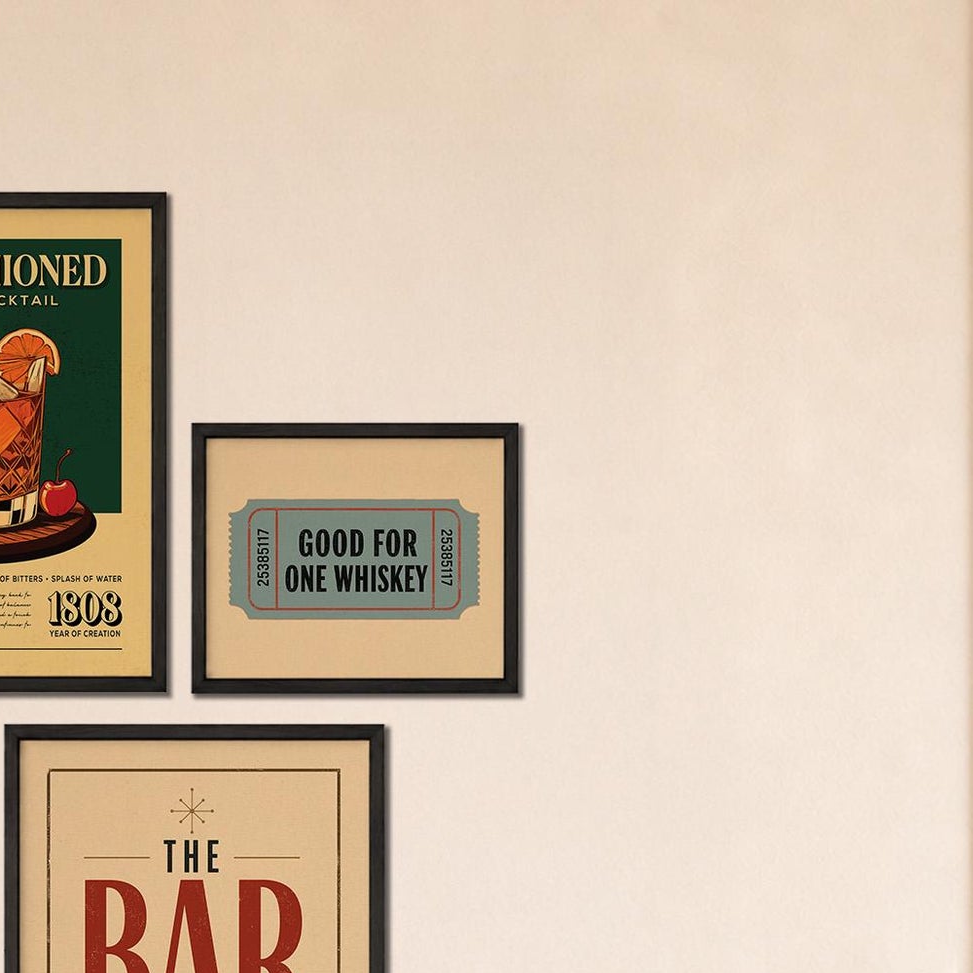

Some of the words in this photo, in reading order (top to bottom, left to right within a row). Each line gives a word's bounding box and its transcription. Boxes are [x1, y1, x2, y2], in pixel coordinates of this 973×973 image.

[257, 529, 269, 587] 25385117
[298, 529, 364, 558] GOOD
[373, 529, 418, 558] FOR
[441, 529, 453, 587] 25385117
[285, 565, 327, 593] ONE
[334, 565, 428, 593] WHISKEY
[48, 590, 123, 627] 1808
[163, 839, 220, 873] THE
